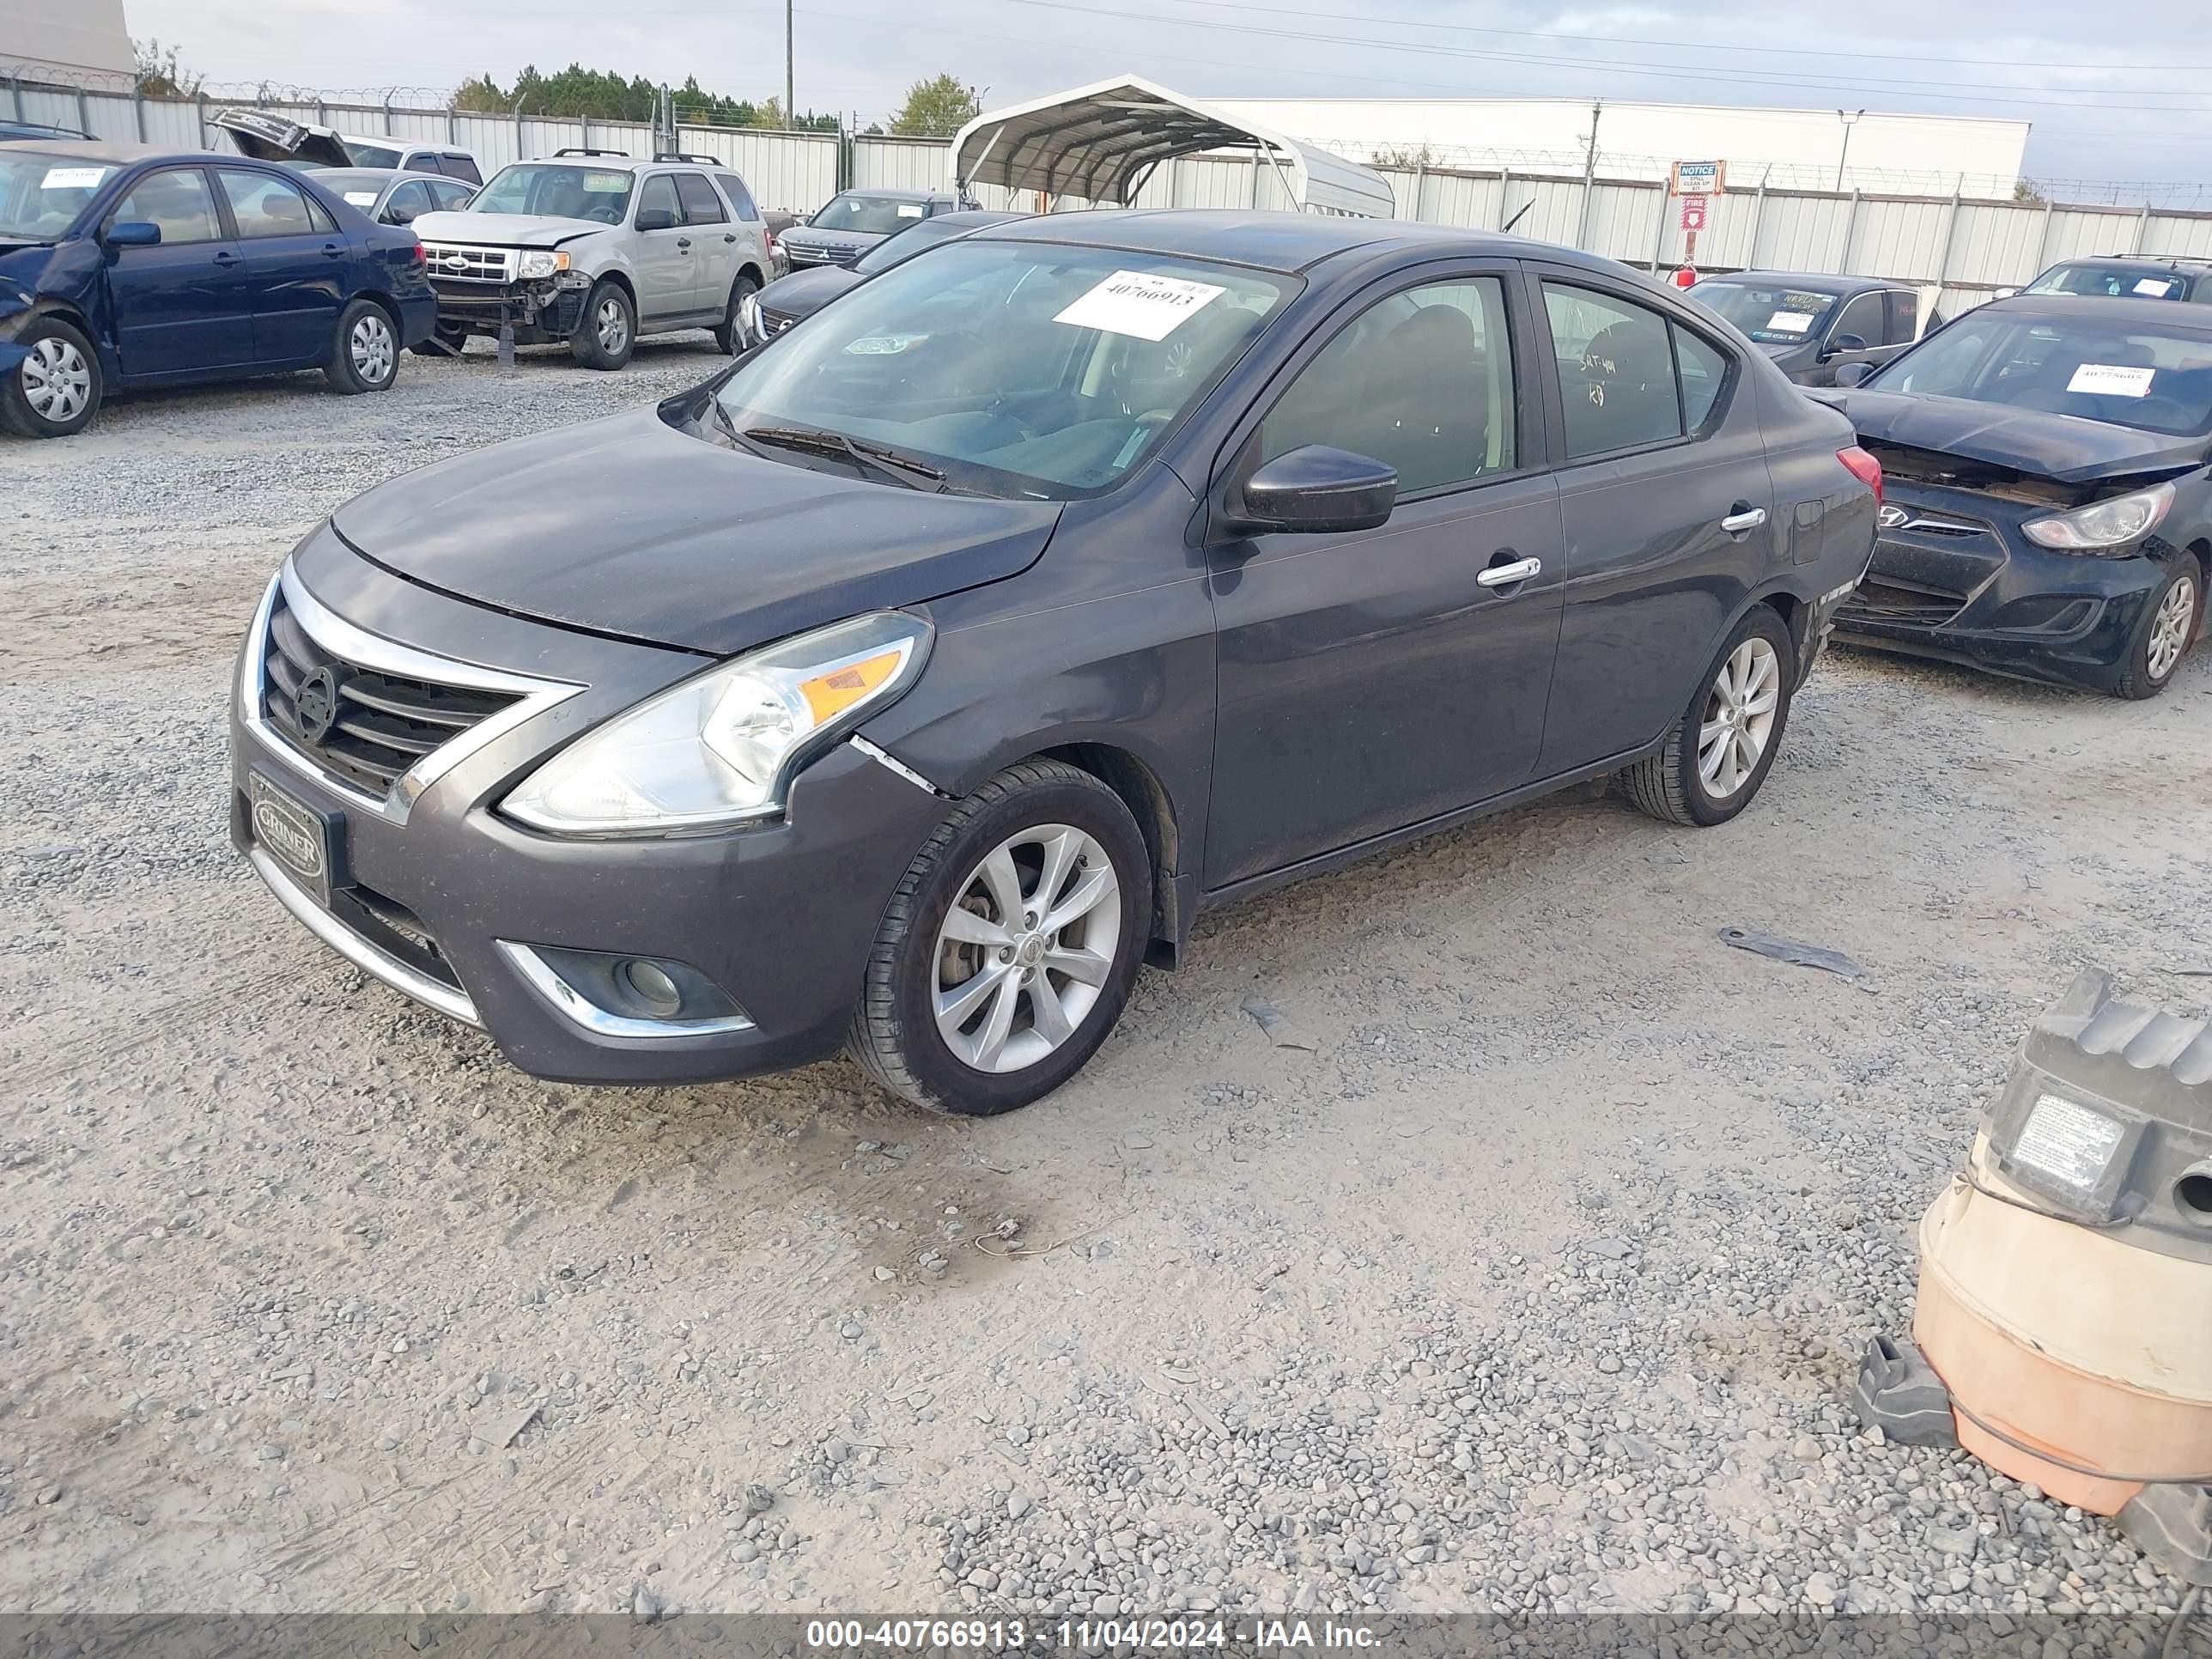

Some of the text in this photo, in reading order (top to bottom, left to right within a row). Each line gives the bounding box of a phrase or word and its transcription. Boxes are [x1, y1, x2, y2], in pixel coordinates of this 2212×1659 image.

[1681, 167, 1715, 175] NOTICE
[1107, 283, 1194, 306] 40766913
[259, 807, 317, 862] GRINER
